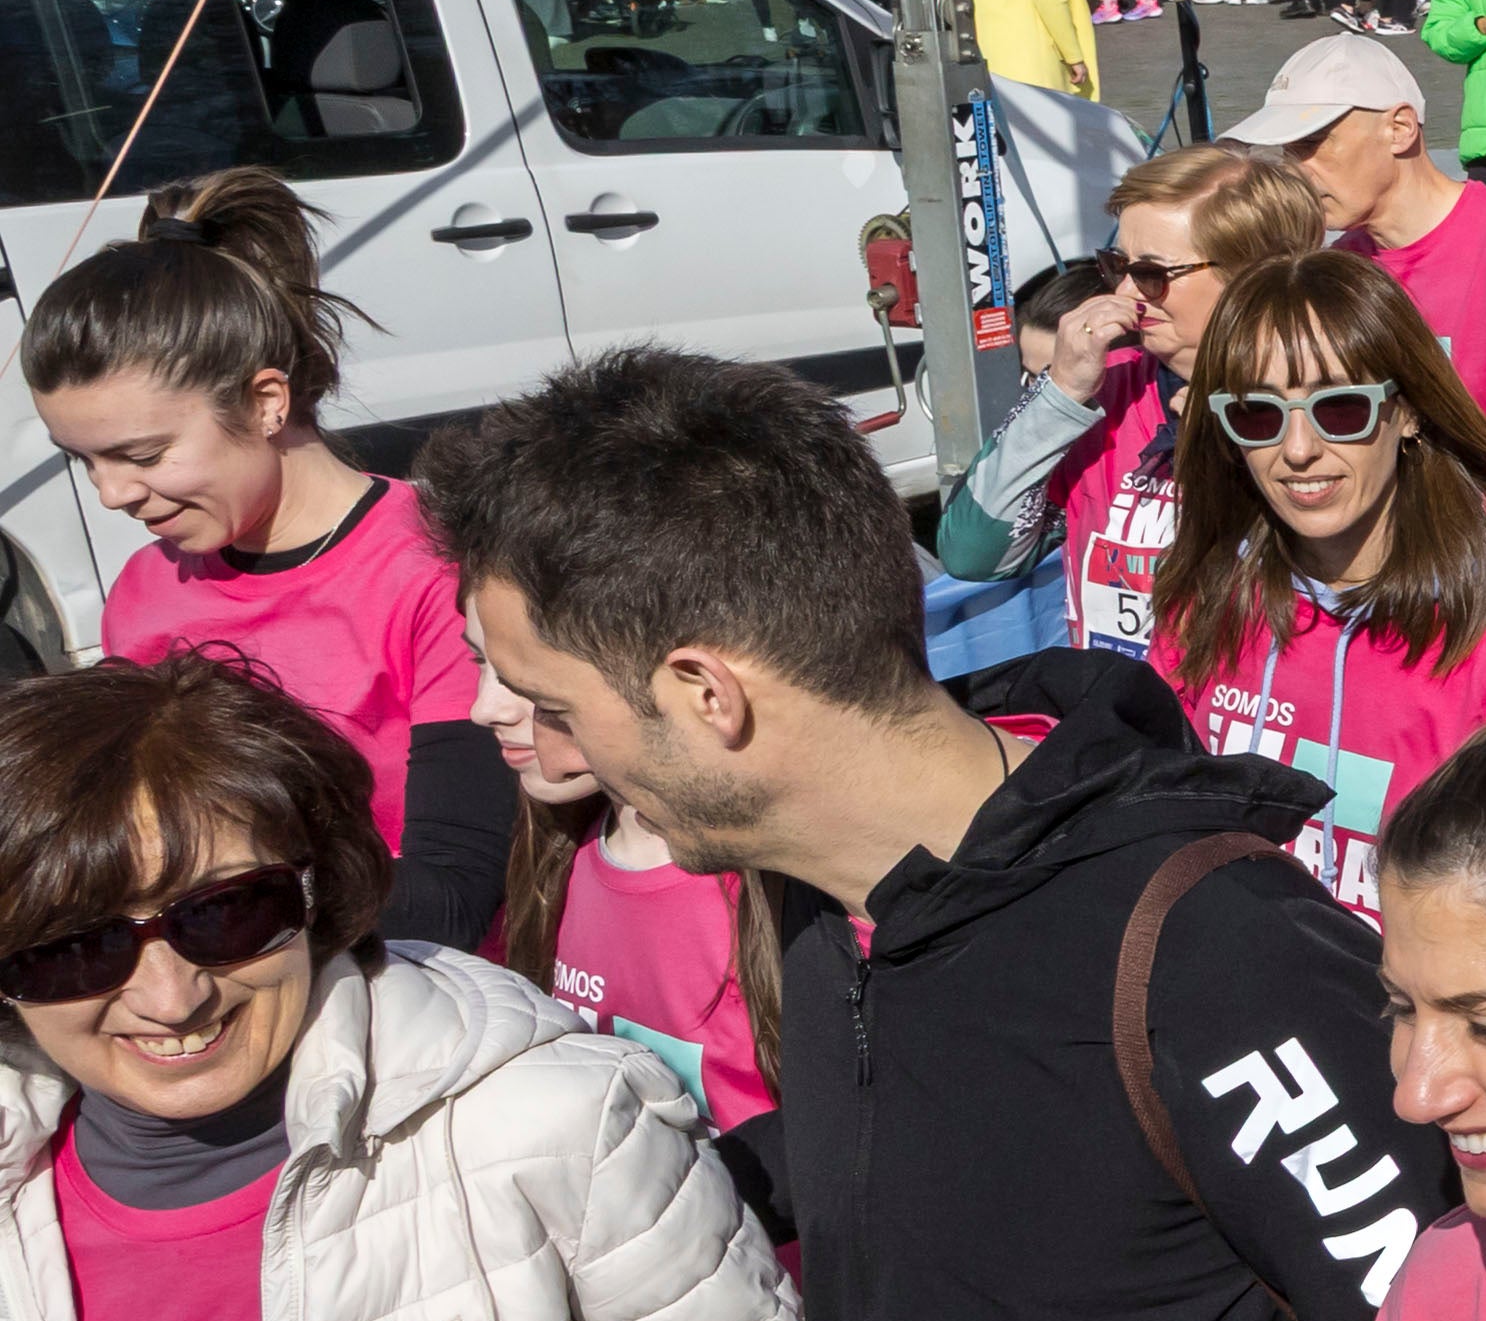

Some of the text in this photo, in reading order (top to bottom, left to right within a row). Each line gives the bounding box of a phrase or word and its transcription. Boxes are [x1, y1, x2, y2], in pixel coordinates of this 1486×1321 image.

[975, 106, 989, 157] TOWER
[952, 114, 992, 305] WORK
[1126, 554, 1144, 574] VI
[1211, 684, 1295, 727] SOMOS
